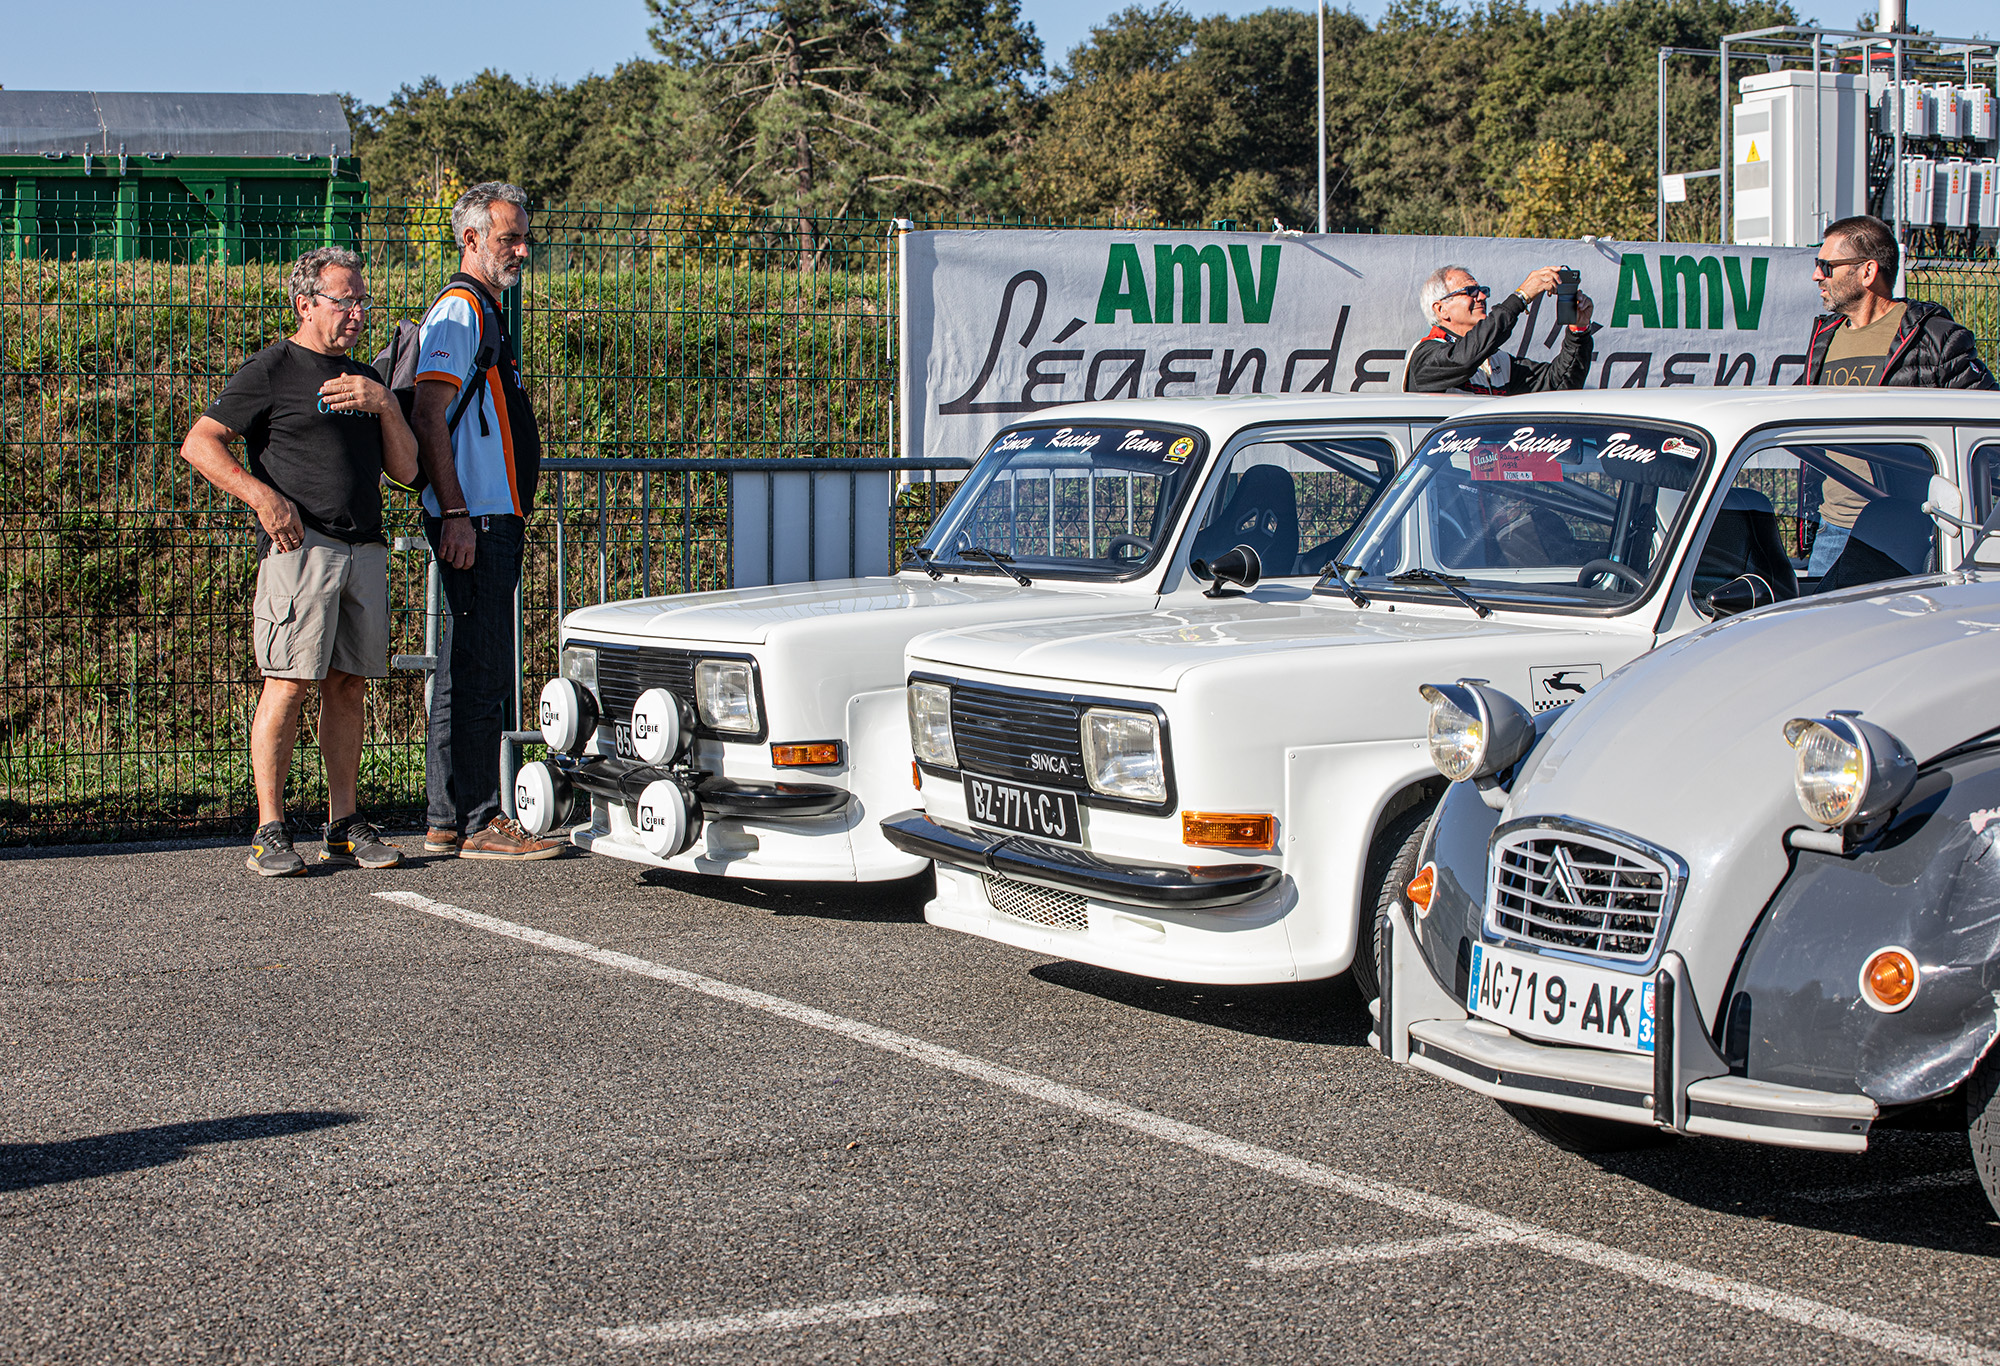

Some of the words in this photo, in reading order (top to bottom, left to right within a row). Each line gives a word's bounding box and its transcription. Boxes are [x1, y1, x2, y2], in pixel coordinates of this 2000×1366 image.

[994, 431, 1035, 454] Simca
[1044, 427, 1102, 455] Racing
[1116, 429, 1163, 454] Team
[1427, 430, 1482, 456] Simca
[1500, 427, 1573, 463] Racing
[1597, 432, 1657, 464] Team
[1473, 451, 1499, 466] Classic
[1505, 471, 1519, 480] ZONE
[1030, 753, 1070, 774] SIMCA
[971, 780, 1066, 837] BZ-771-CJ
[1480, 957, 1634, 1038] AG-719-AK
